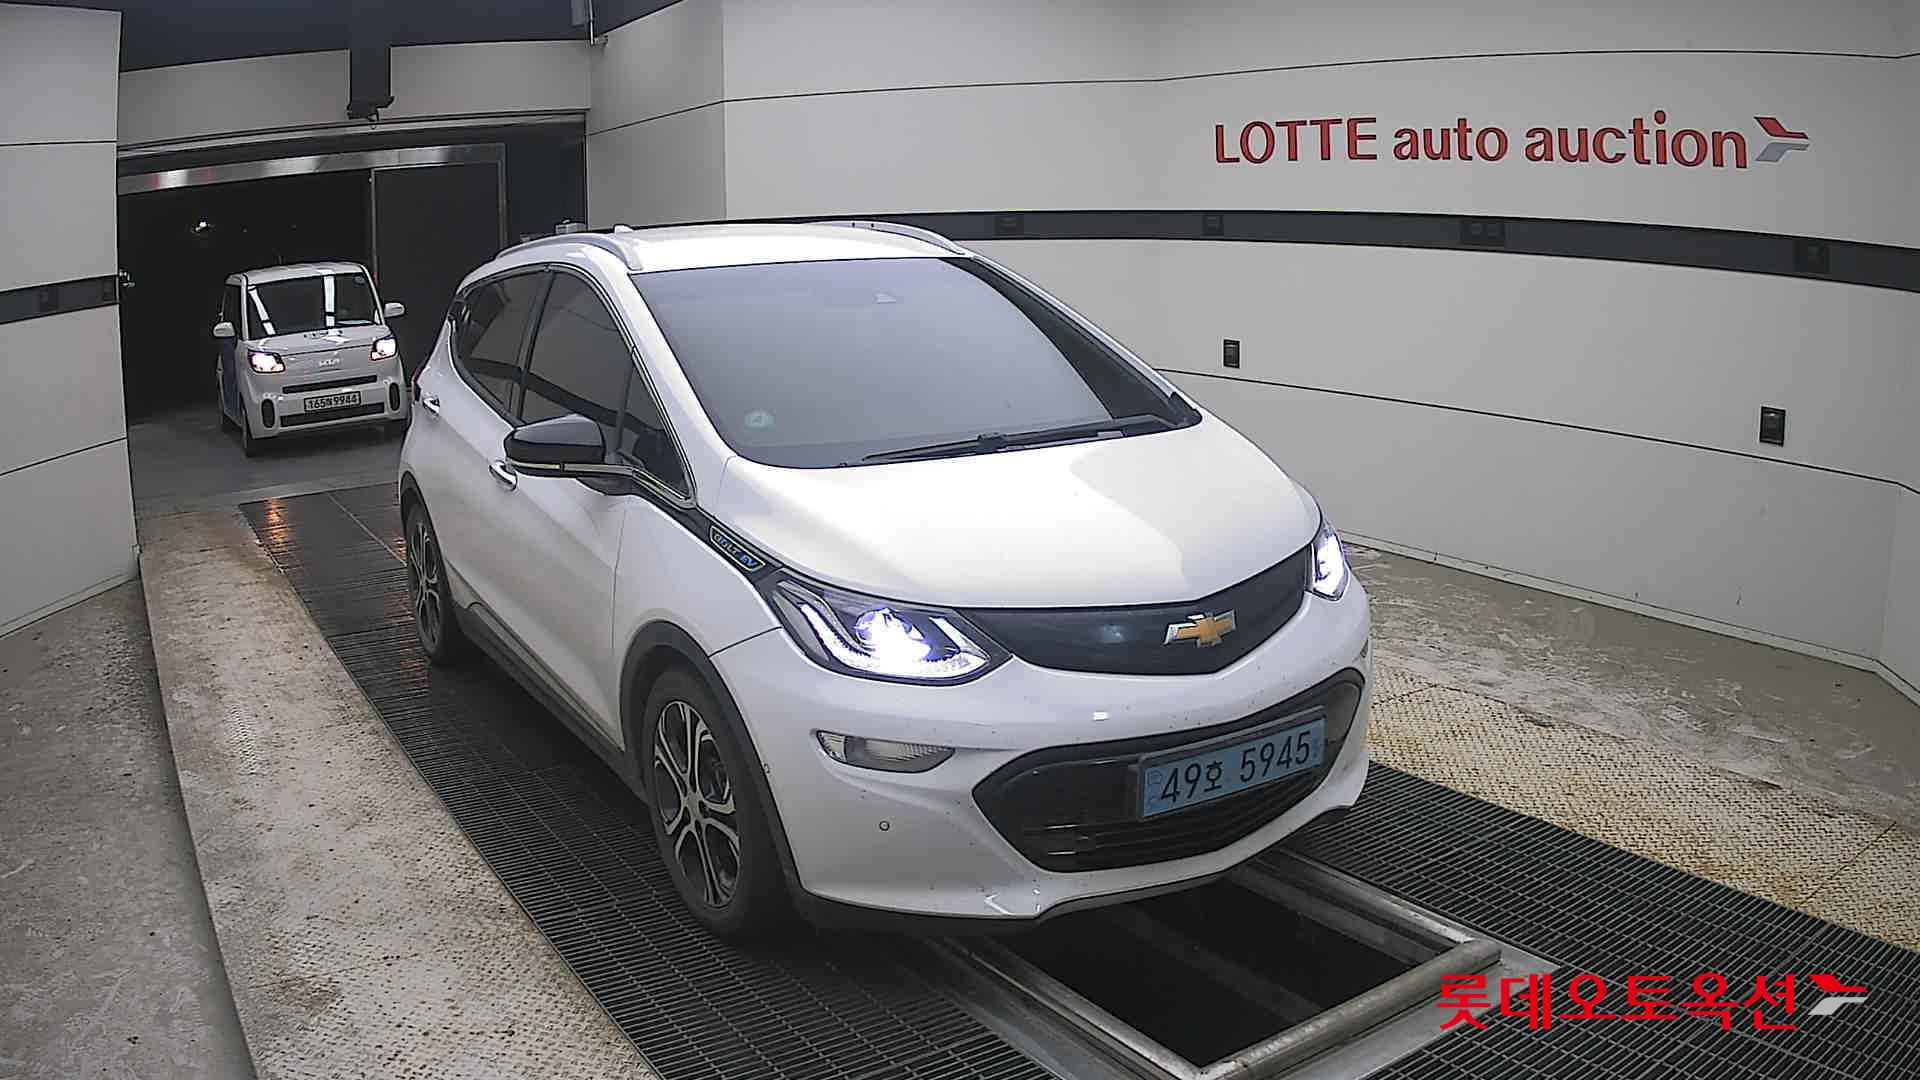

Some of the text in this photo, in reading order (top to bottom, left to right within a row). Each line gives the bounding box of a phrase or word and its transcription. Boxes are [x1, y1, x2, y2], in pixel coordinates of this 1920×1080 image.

[1214, 110, 1749, 169] LOTTE auto auction
[1160, 730, 1312, 803] 49호 5945
